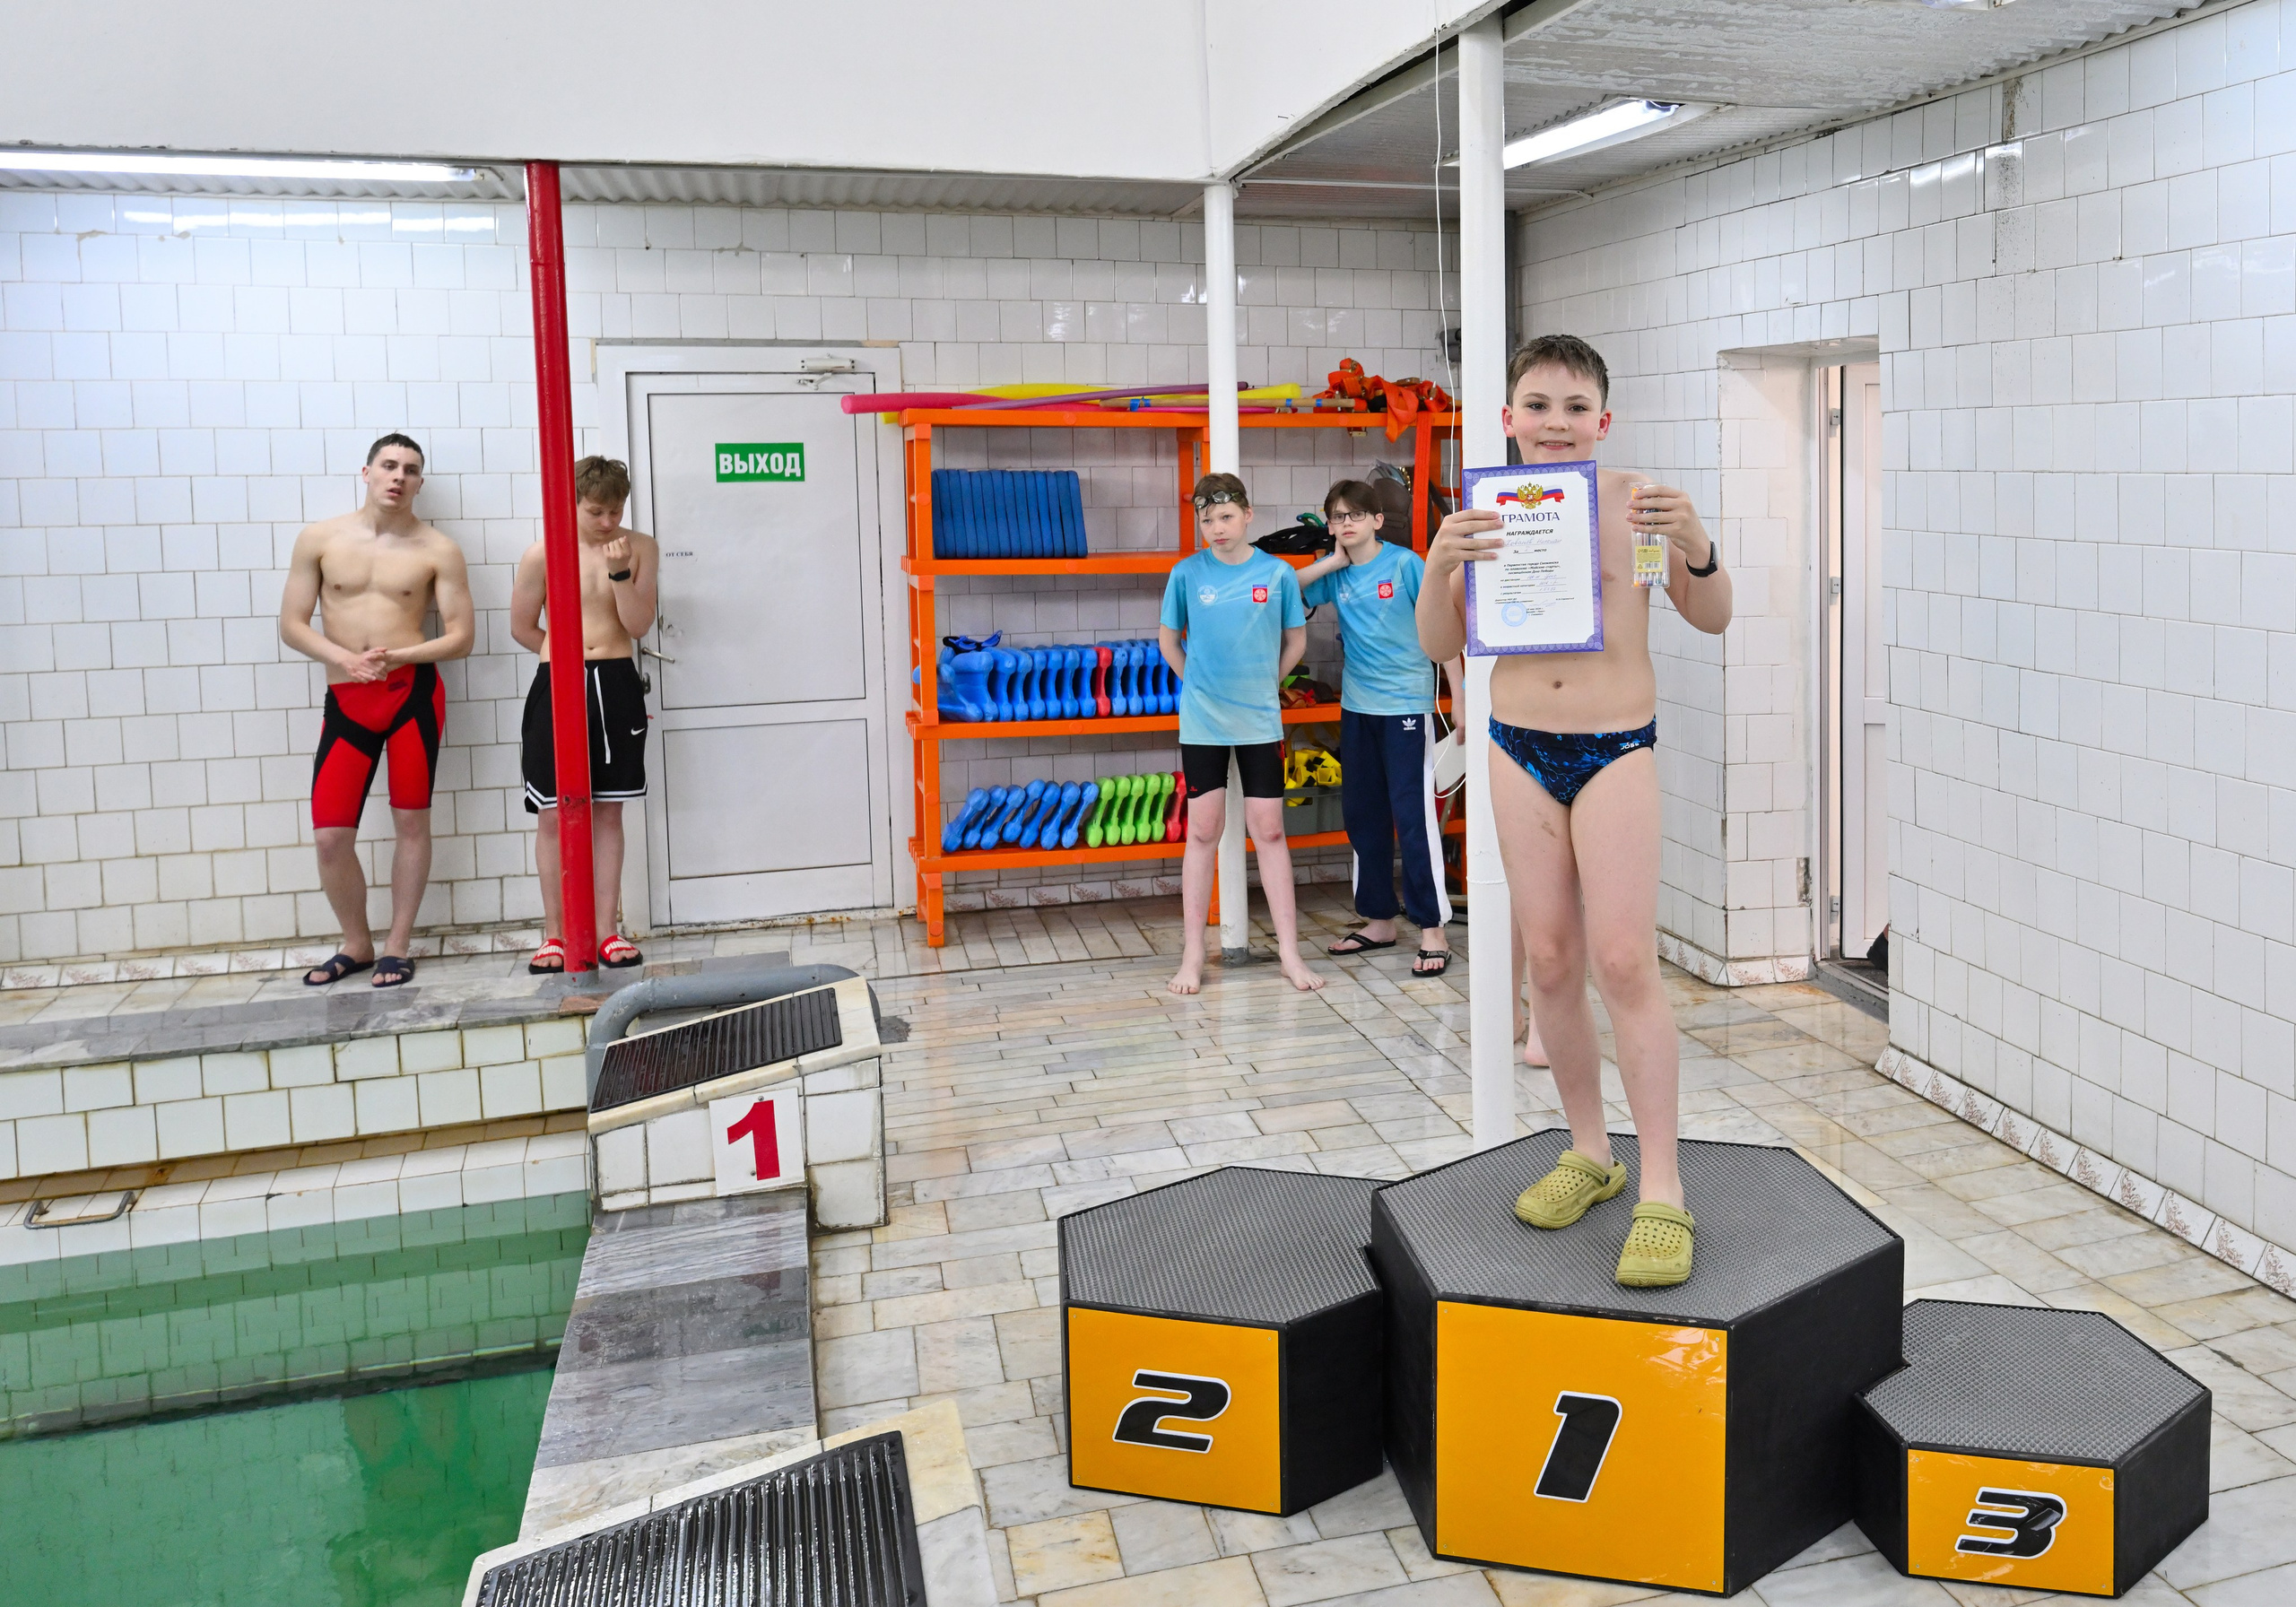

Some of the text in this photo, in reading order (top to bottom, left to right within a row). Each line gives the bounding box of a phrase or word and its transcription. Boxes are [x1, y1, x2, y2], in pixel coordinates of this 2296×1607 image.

[718, 452, 801, 477] ВЫХОД
[1501, 511, 1561, 524] ГРАМОТА
[1506, 528, 1554, 537] НАГРАЖДАЕТСЯ
[726, 1099, 780, 1181] 1
[1112, 1368, 1231, 1454] 2
[1534, 1390, 1622, 1503] 1
[1954, 1486, 2067, 1559] 3
